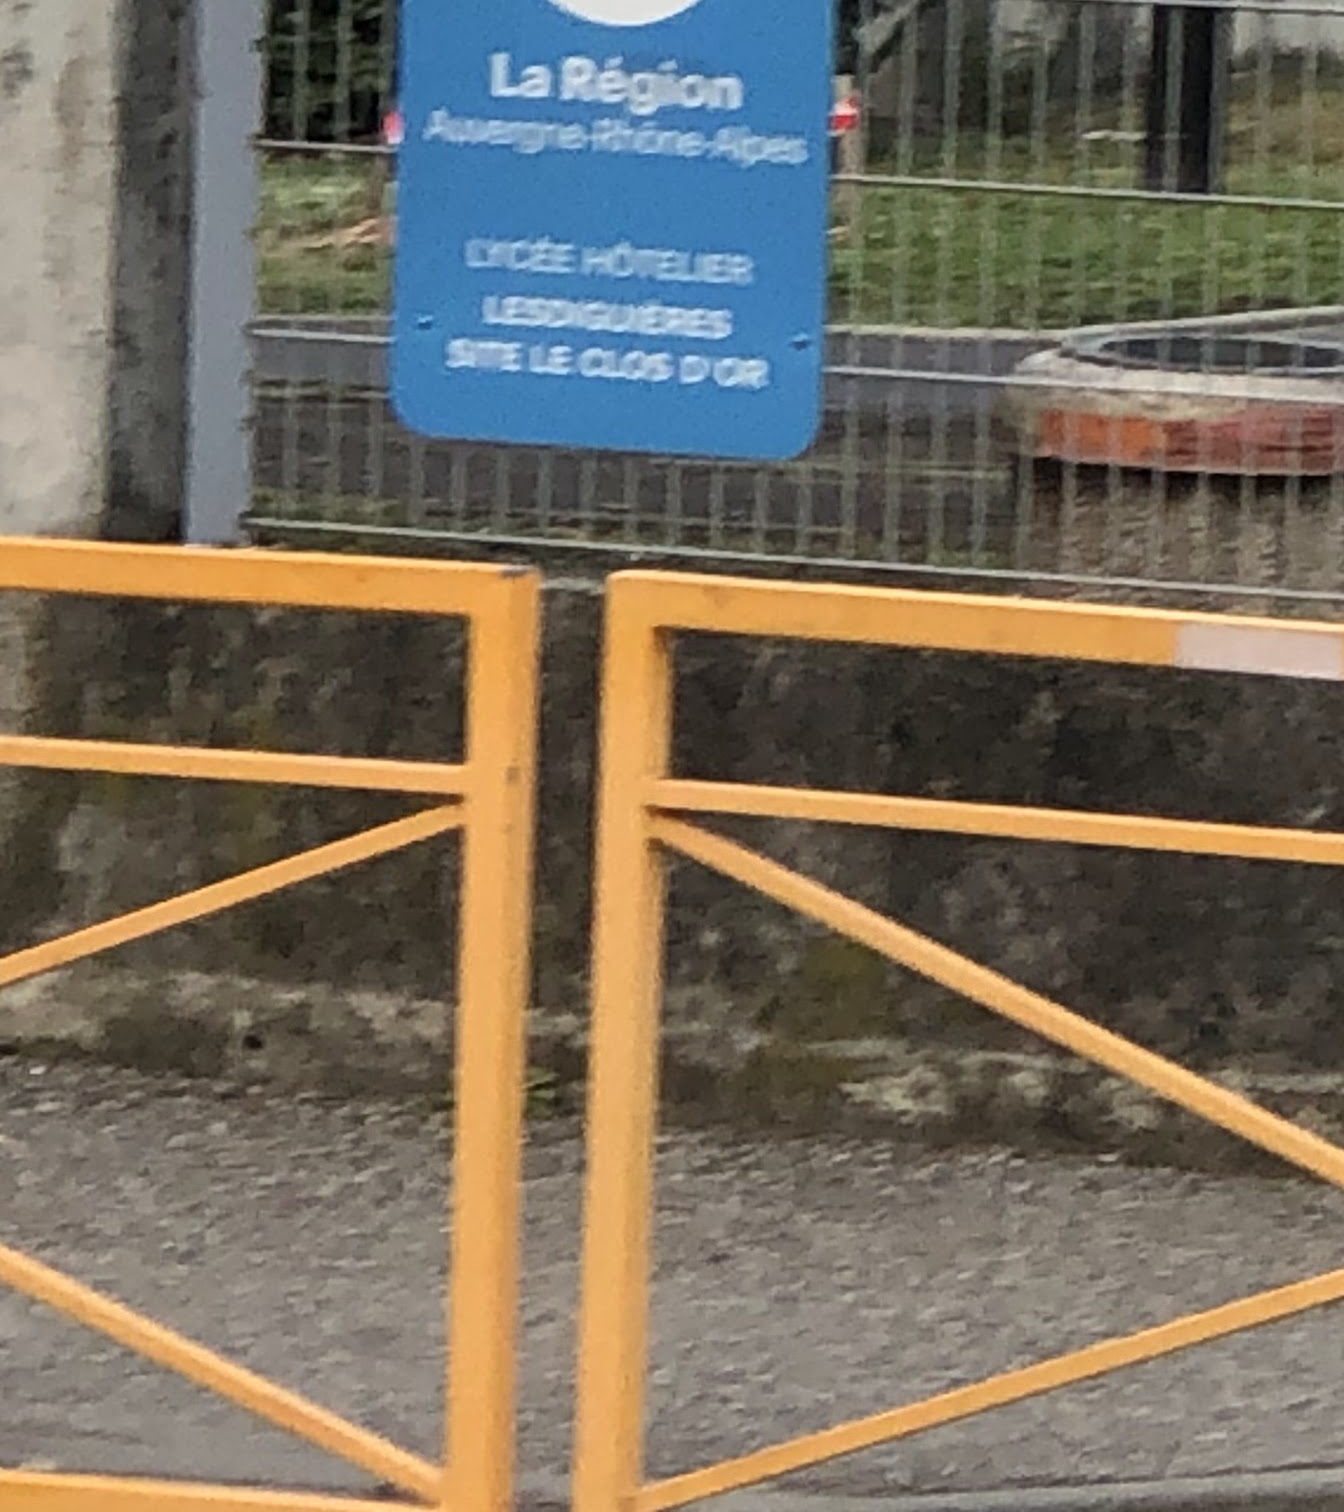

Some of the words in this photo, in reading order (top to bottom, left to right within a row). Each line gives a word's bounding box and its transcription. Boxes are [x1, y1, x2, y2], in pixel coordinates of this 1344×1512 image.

[489, 51, 553, 99] La
[558, 54, 745, 117] Région
[421, 106, 809, 170] Auvergne-Rhône-Alpes
[463, 234, 578, 275] LYCÉE
[580, 240, 755, 287] HÔTELIER
[481, 294, 735, 341] LESDIGUIÈRES
[445, 338, 523, 373] SITE
[527, 344, 575, 377] LE
[576, 347, 675, 384] CLOS
[678, 353, 771, 392] D'OR
